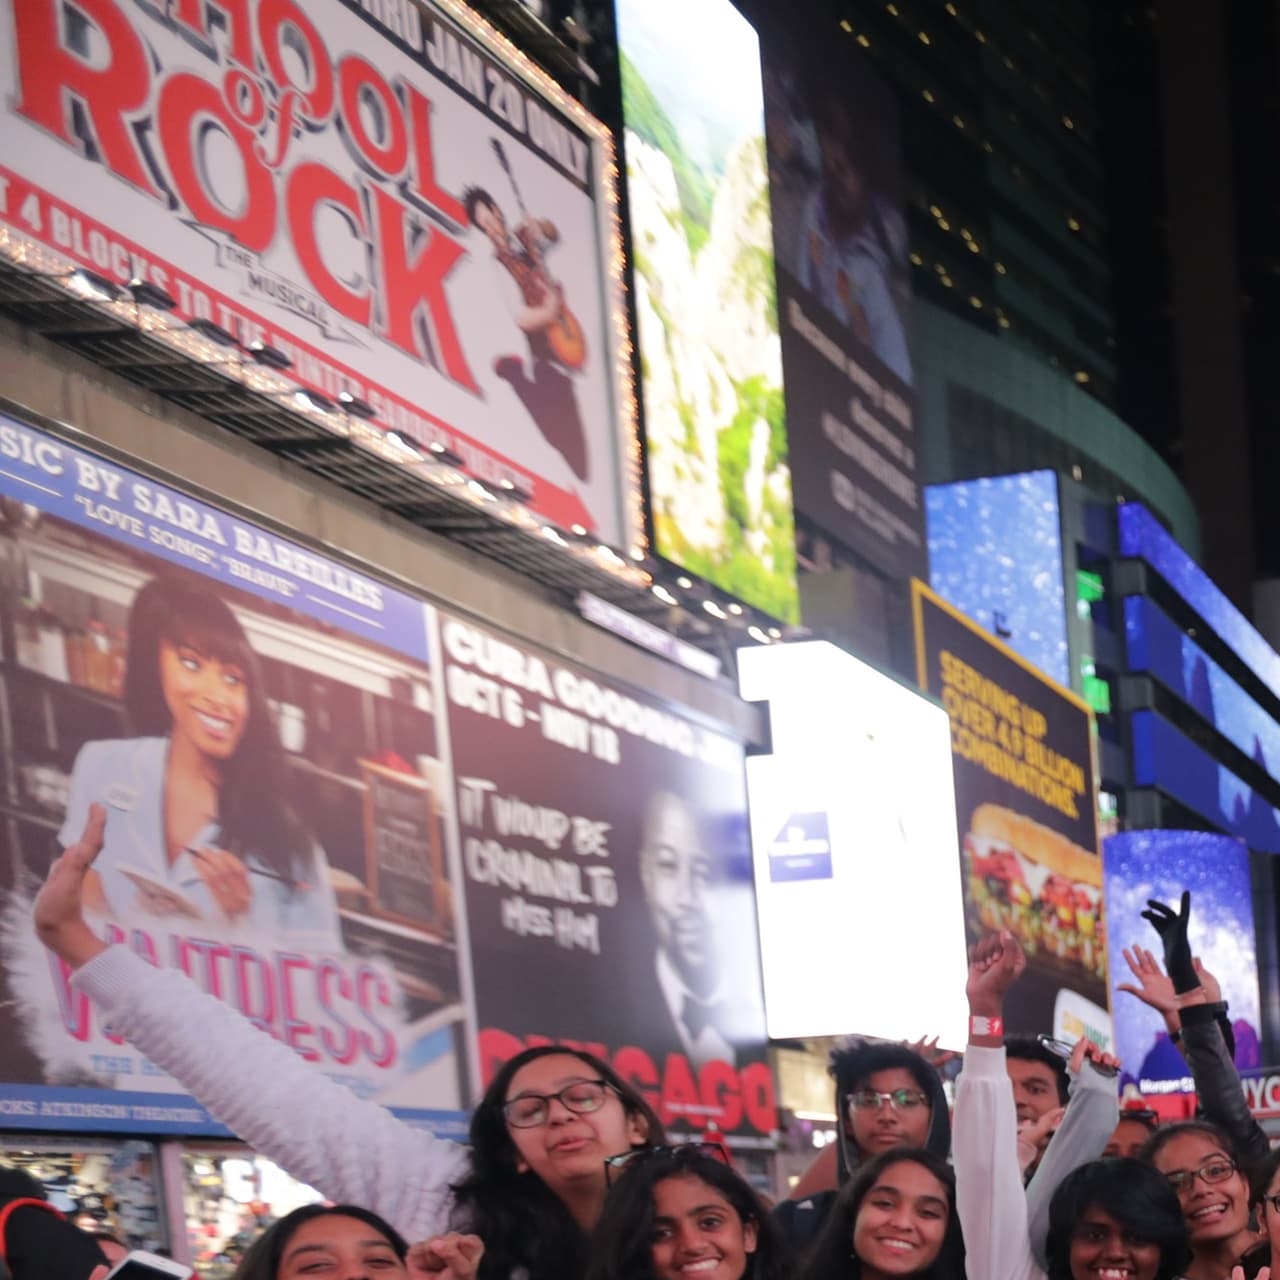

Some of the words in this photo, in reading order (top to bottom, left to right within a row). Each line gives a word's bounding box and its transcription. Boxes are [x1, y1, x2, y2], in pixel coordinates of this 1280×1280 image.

[425, 20, 485, 101] JAN
[486, 66, 525, 134] 20
[526, 98, 590, 186] ONLY
[14, 0, 484, 397] ROCK
[50, 203, 169, 294] BLOCKS
[175, 273, 213, 322] TO
[225, 245, 254, 269] THE
[247, 271, 328, 320] MUSICAL
[75, 457, 122, 502] BY
[133, 483, 228, 547] SARA
[233, 525, 385, 611] BAREILLES
[442, 620, 554, 698] CUBA
[446, 664, 500, 719] OCT
[501, 690, 526, 728] 6
[940, 650, 1020, 727] SERVING
[1021, 704, 1047, 737] UP
[942, 684, 998, 739] OVER
[1024, 735, 1086, 795] BILLION
[570, 815, 613, 858] BE
[478, 1028, 778, 1135] CCAGO
